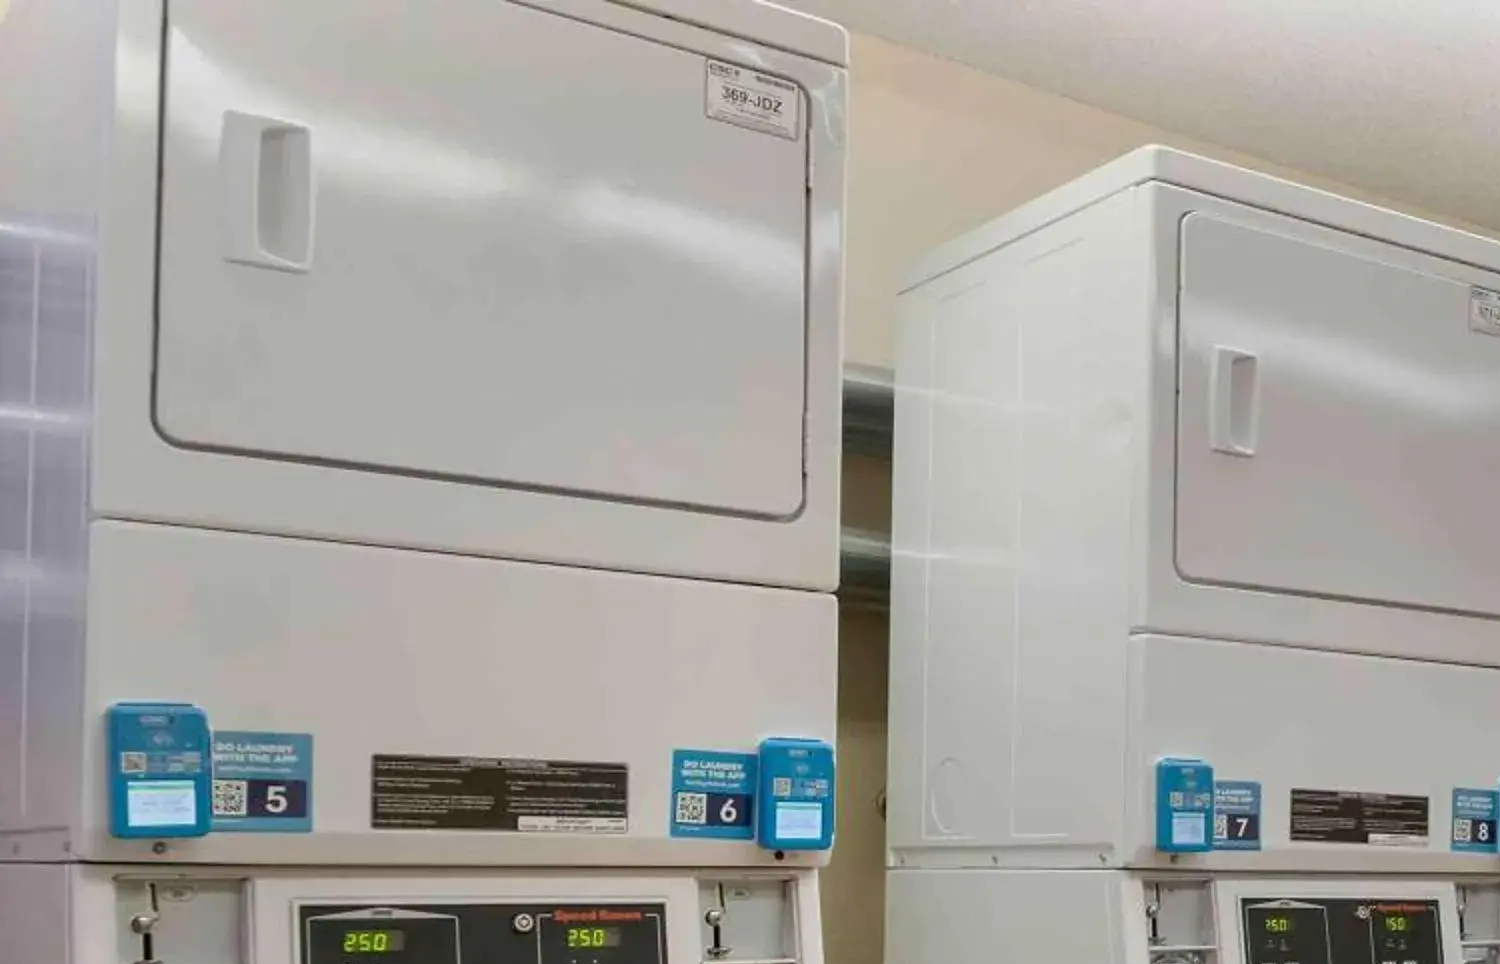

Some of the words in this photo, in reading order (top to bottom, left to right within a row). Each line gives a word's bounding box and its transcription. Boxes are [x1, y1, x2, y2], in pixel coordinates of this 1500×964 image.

[721, 84, 783, 114] 369-JDZ
[265, 785, 288, 813] 5
[719, 798, 737, 823] 6
[1235, 818, 1248, 837] 7
[1478, 822, 1489, 842] 8
[343, 933, 388, 952] 250
[567, 929, 605, 947] 250
